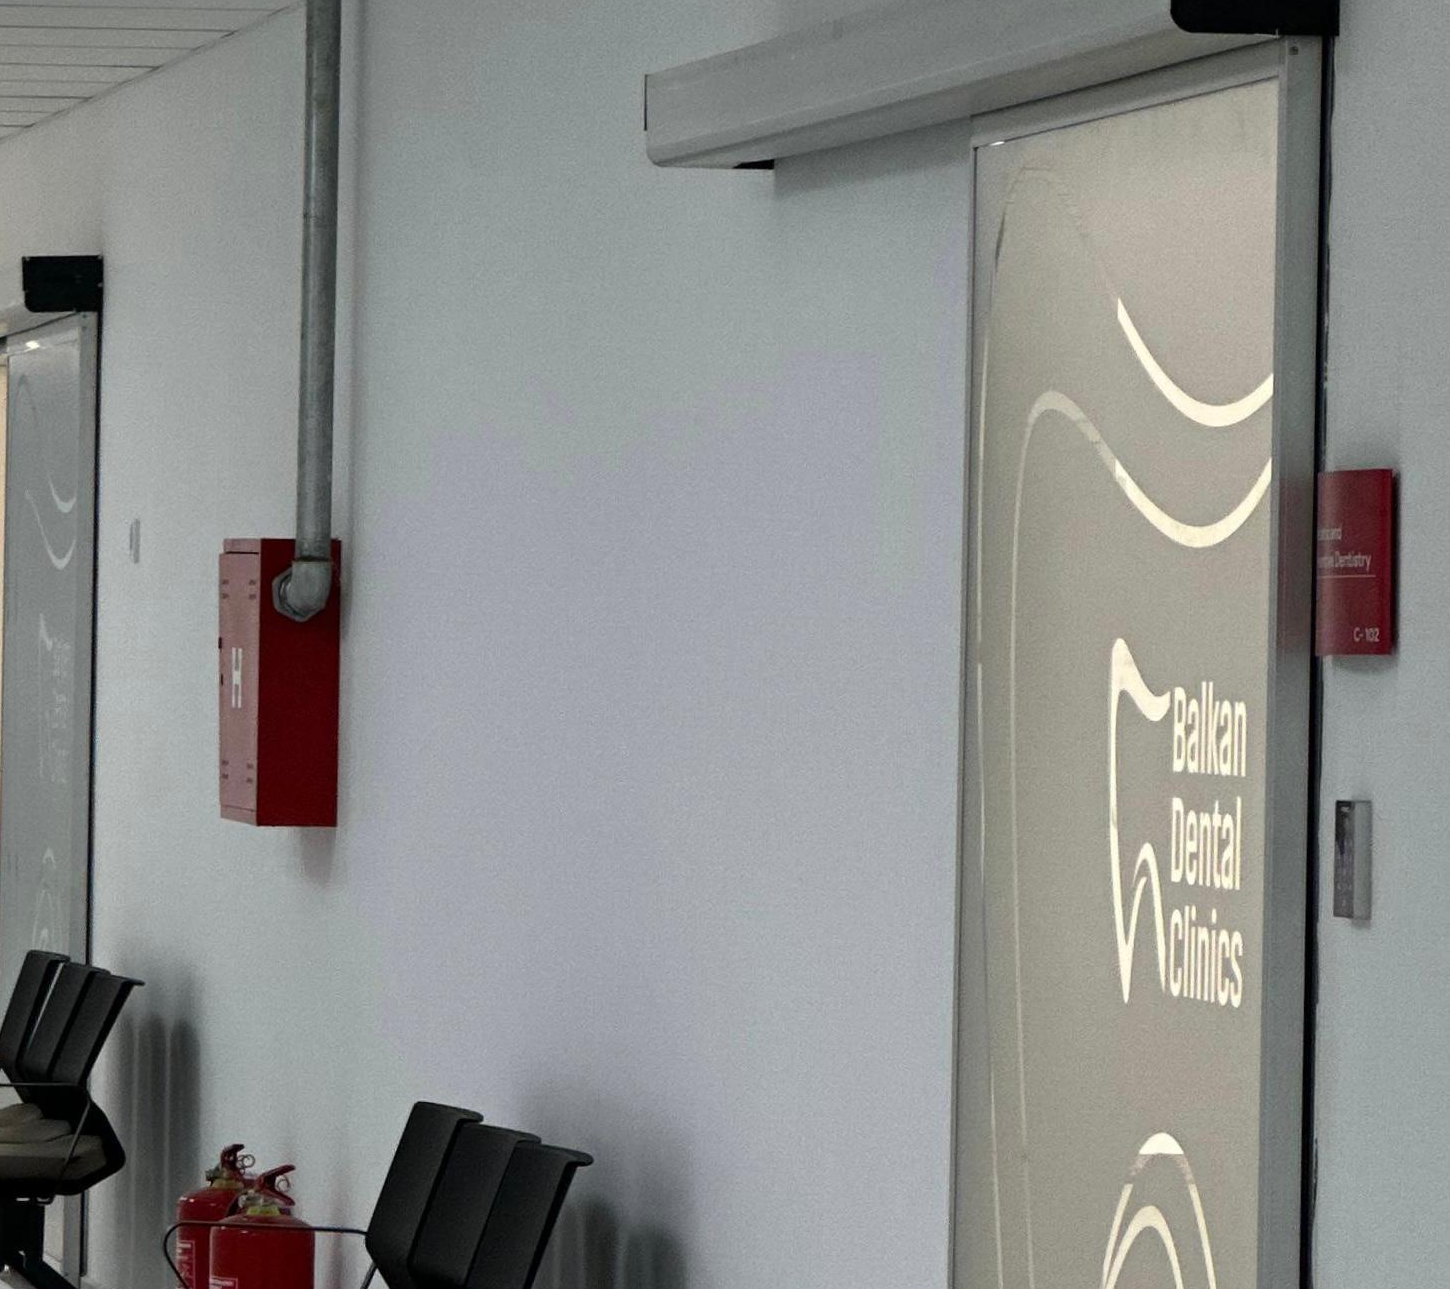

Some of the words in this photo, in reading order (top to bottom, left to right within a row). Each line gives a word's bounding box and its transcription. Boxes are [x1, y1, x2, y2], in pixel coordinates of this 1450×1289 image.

[1334, 551, 1372, 572] Dentistry
[1172, 681, 1247, 777] Balkan
[1170, 796, 1242, 890] Dental
[1169, 905, 1243, 1008] Clinics
